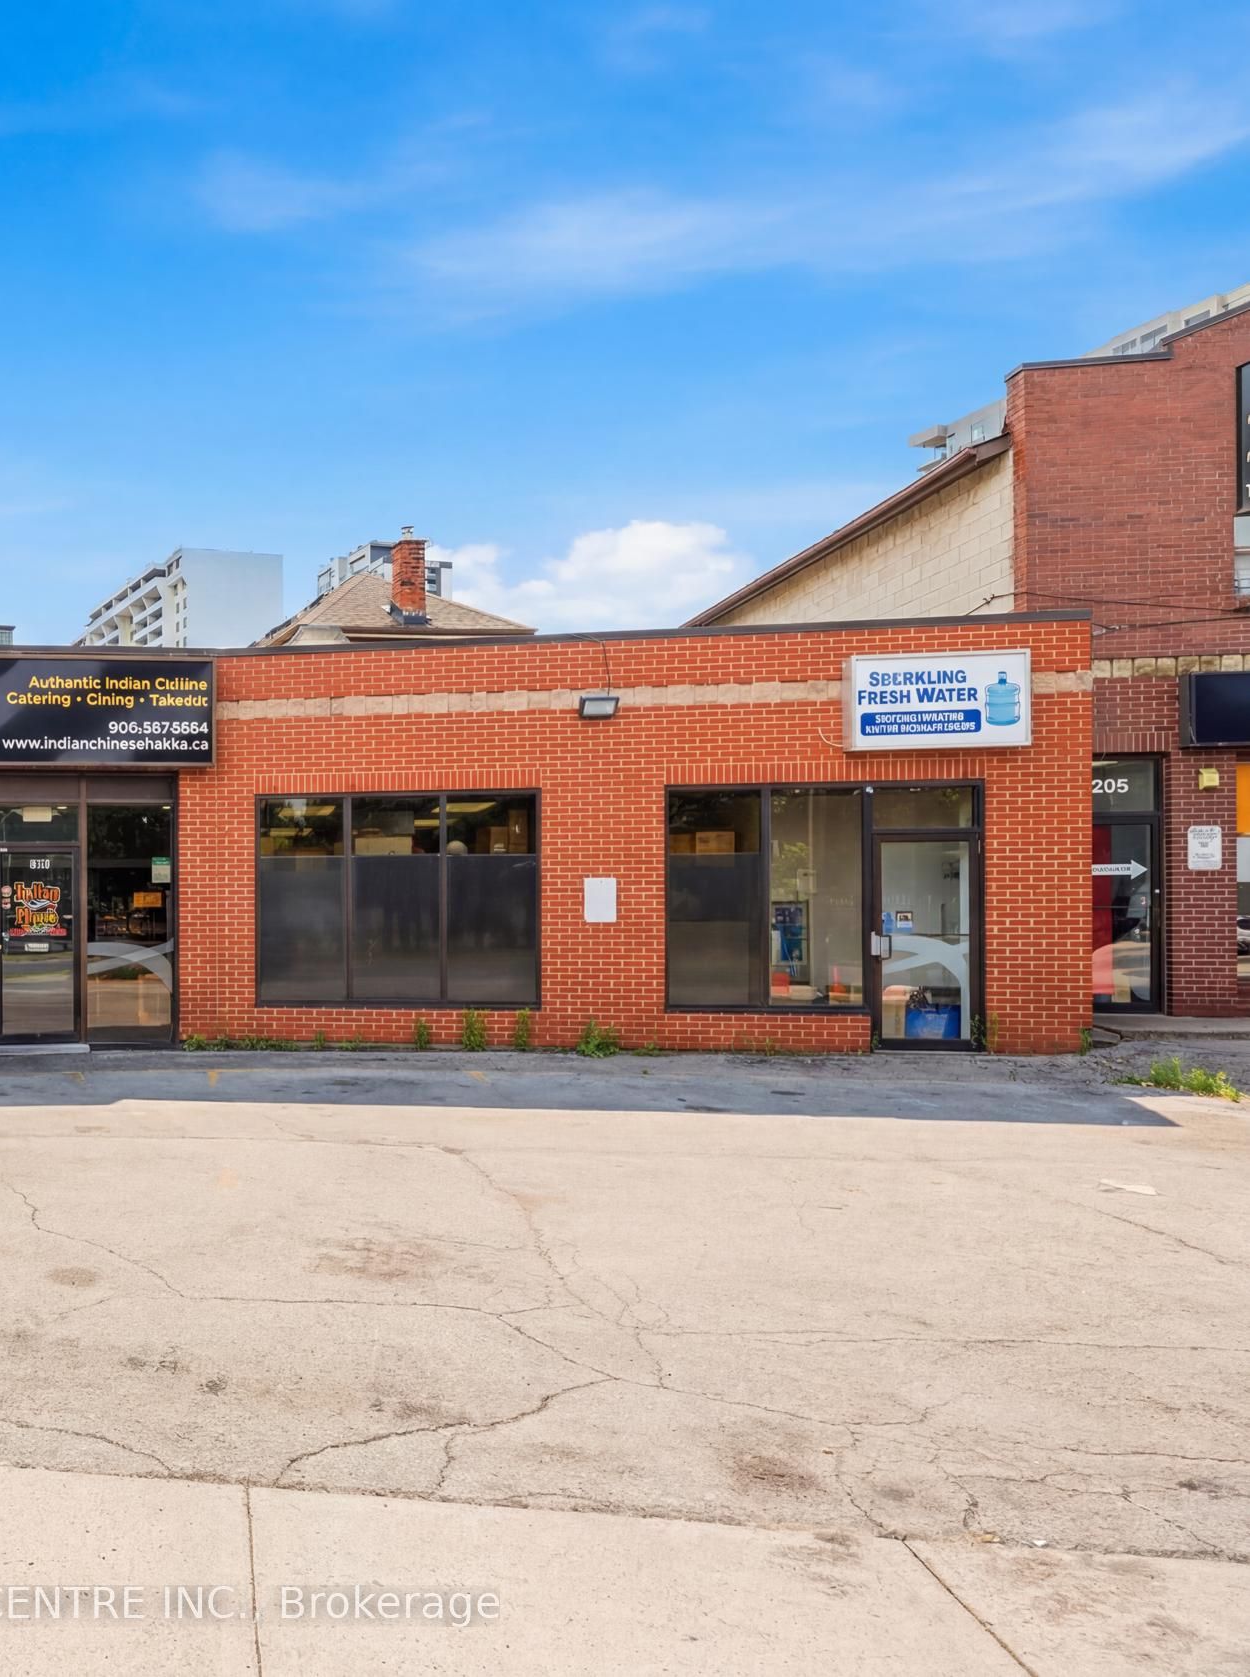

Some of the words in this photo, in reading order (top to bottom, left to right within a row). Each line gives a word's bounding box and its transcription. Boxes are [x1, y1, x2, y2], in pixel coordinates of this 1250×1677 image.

[105, 676, 151, 691] Indian
[6, 691, 72, 708] Catering
[86, 693, 135, 709] Cining
[857, 689, 911, 706] FRESH
[915, 687, 979, 704] WATER
[1, 736, 210, 751] www.indianchinesehakka.ca
[1091, 778, 1130, 794] 205
